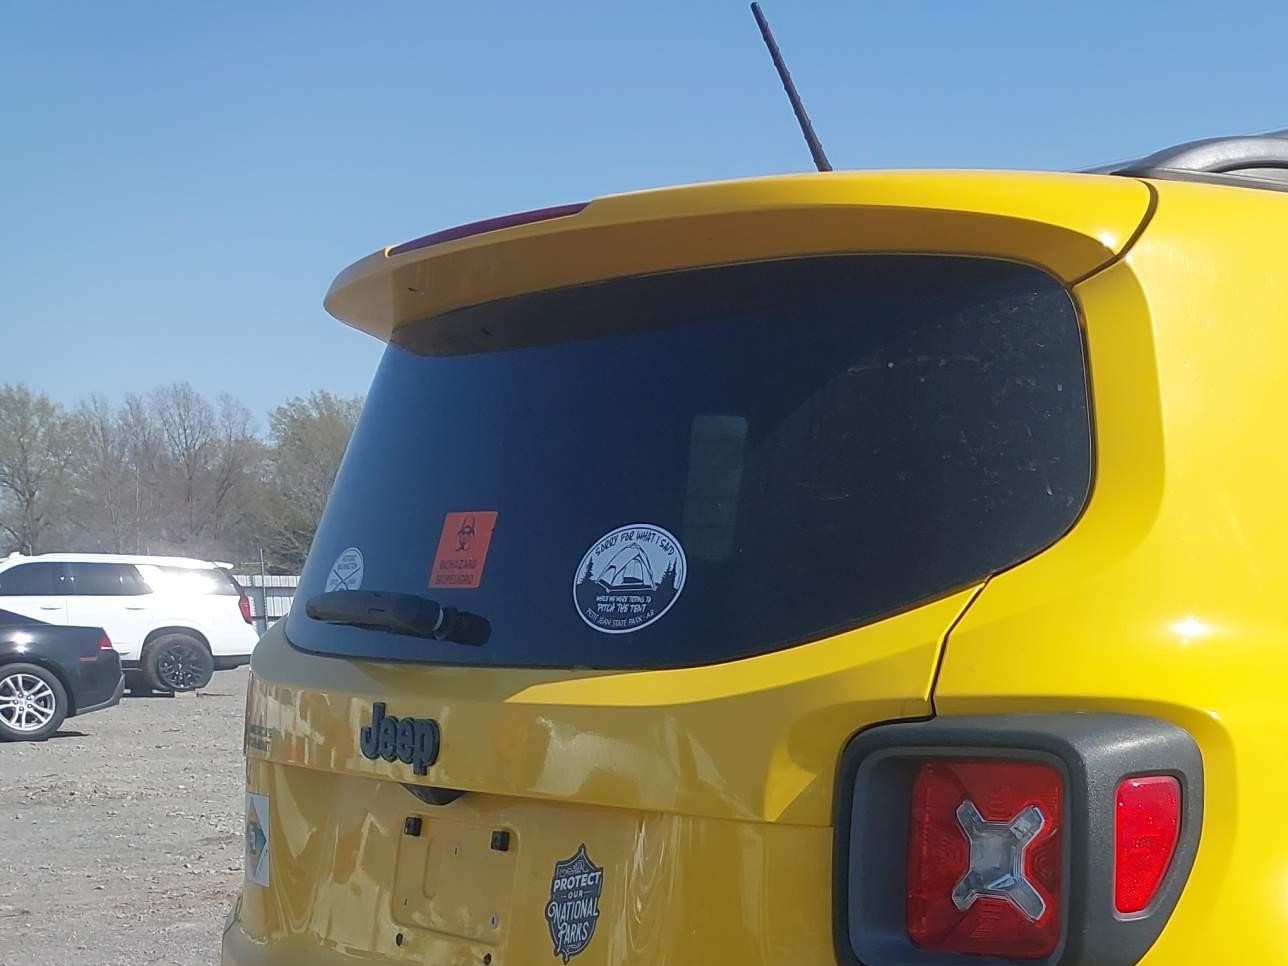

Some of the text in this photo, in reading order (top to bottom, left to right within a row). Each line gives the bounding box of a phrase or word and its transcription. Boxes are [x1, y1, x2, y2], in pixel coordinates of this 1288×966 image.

[595, 534, 619, 556] SORRY
[620, 531, 635, 542] FOR
[636, 531, 656, 544] WHAT
[659, 538, 675, 556] SAID
[440, 560, 478, 569] BIOHAZARD
[597, 603, 647, 614] PITCH THE TENT
[612, 618, 627, 628] STATE
[628, 616, 643, 626] PARK
[360, 702, 440, 776] Jeep
[553, 871, 602, 892] PROTECT
[568, 889, 583, 899] OUR
[547, 896, 599, 929] NATIONAL
[557, 921, 589, 953] PARKS
